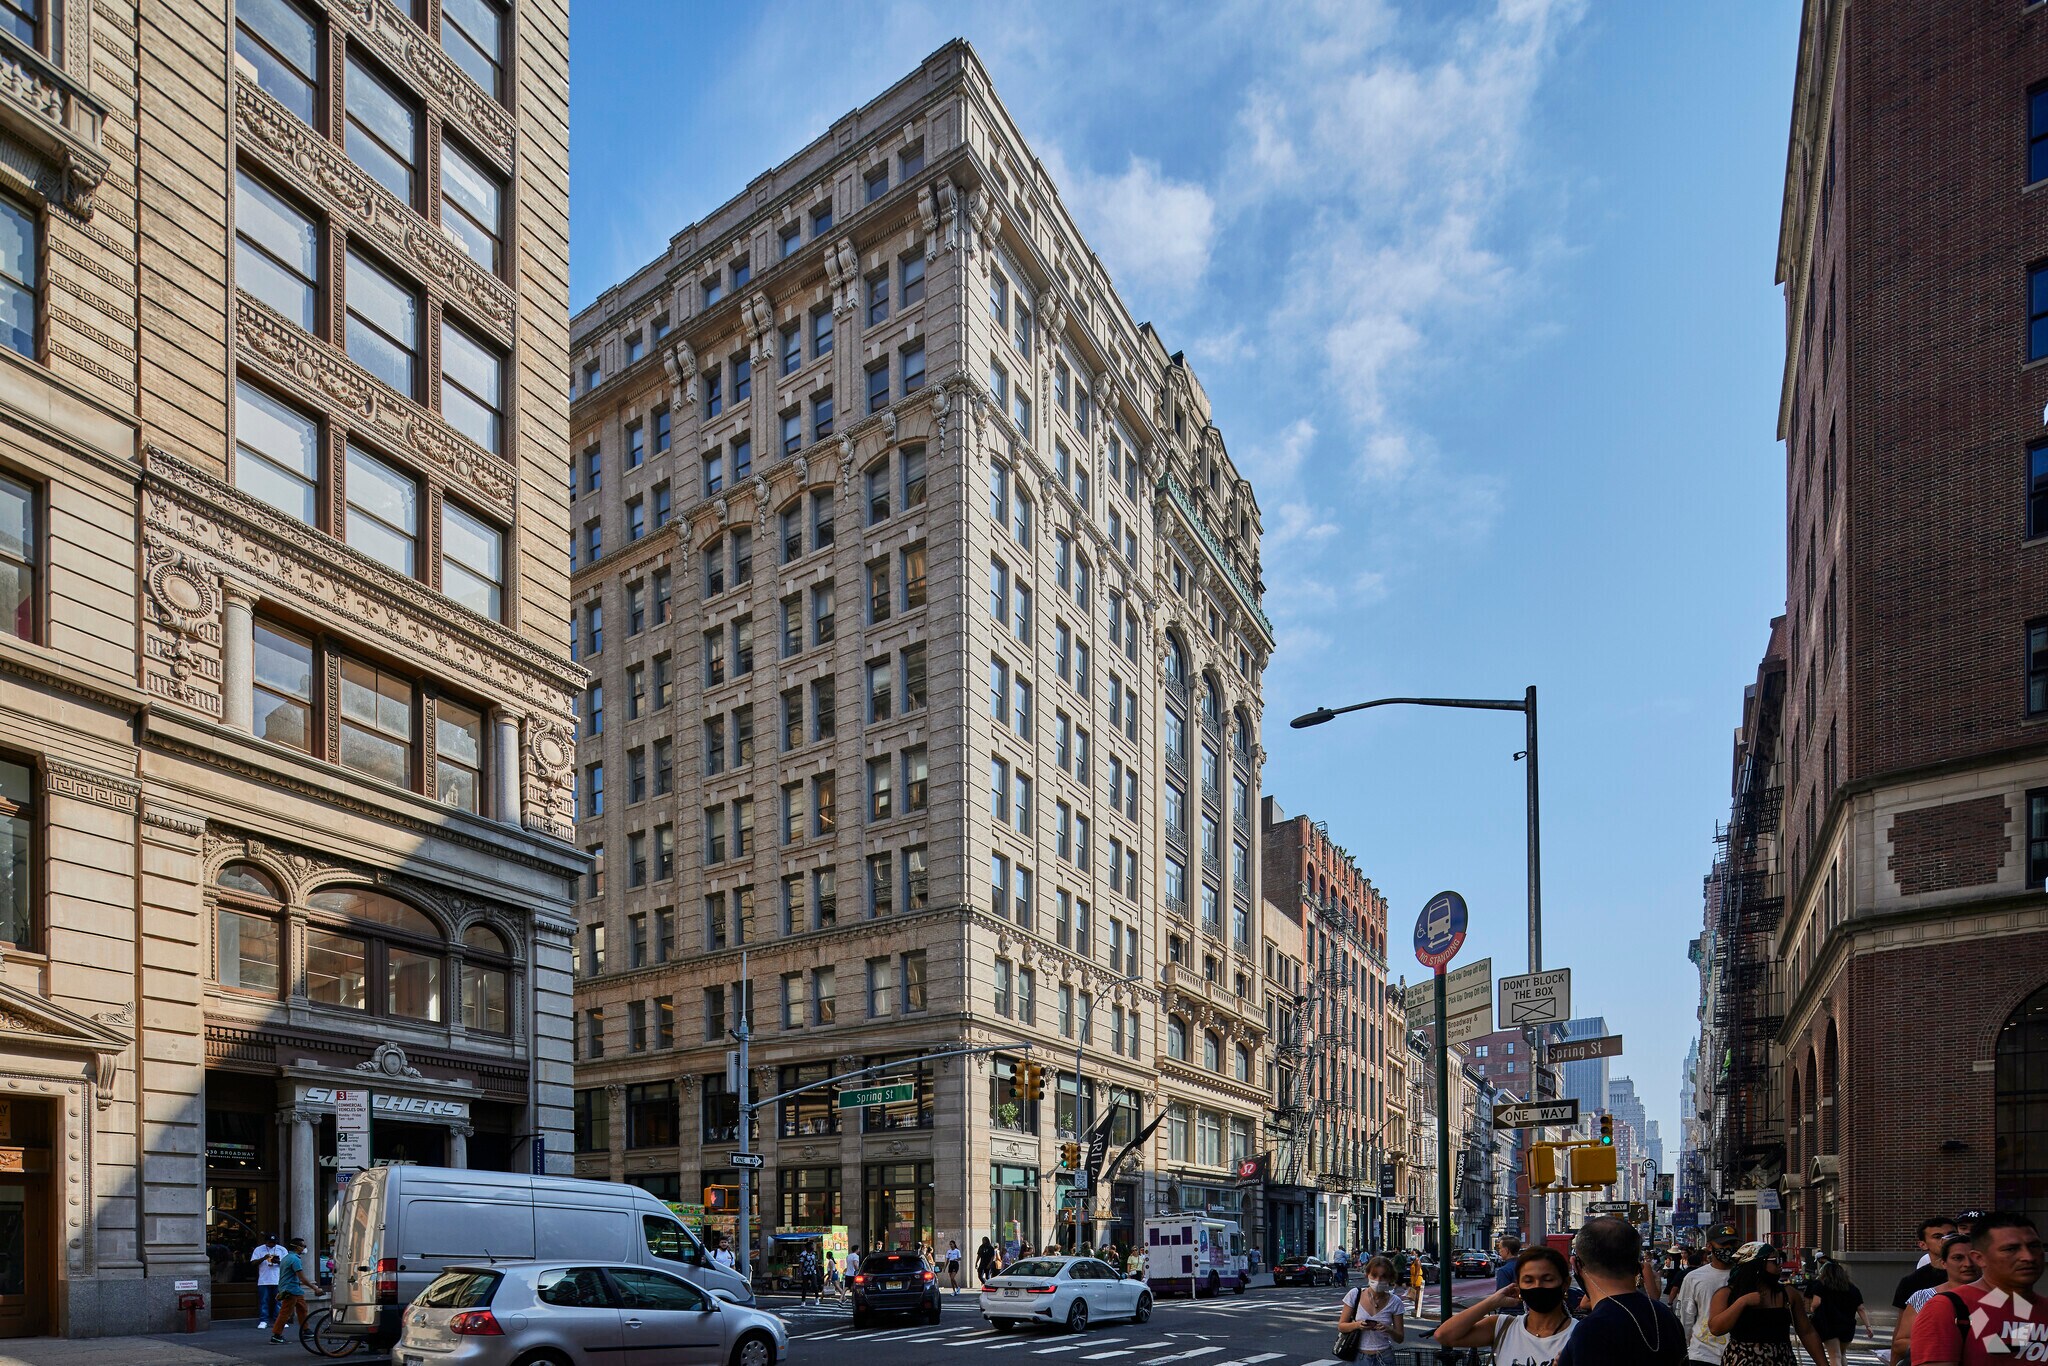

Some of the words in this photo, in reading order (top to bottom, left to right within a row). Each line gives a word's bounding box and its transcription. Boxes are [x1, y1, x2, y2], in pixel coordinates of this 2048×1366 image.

[1419, 952, 1428, 964] NO
[1429, 939, 1460, 965] STANDING
[1503, 978, 1530, 991] DON'T
[1533, 973, 1565, 986] BLOCK
[1514, 989, 1531, 1000] THE
[1535, 986, 1554, 998] BOX
[1448, 1016, 1472, 1029] Broadway
[1448, 1028, 1464, 1039] Spring
[1466, 1025, 1472, 1034] St
[1550, 1046, 1585, 1061] Spring
[1590, 1042, 1602, 1055] St
[304, 1087, 464, 1116] SCHERS
[856, 1092, 882, 1104] Spring
[885, 1089, 894, 1100] St
[1505, 1110, 1529, 1122] ONE
[1540, 1107, 1567, 1119] WAY
[2001, 1320, 2048, 1342] NEW
